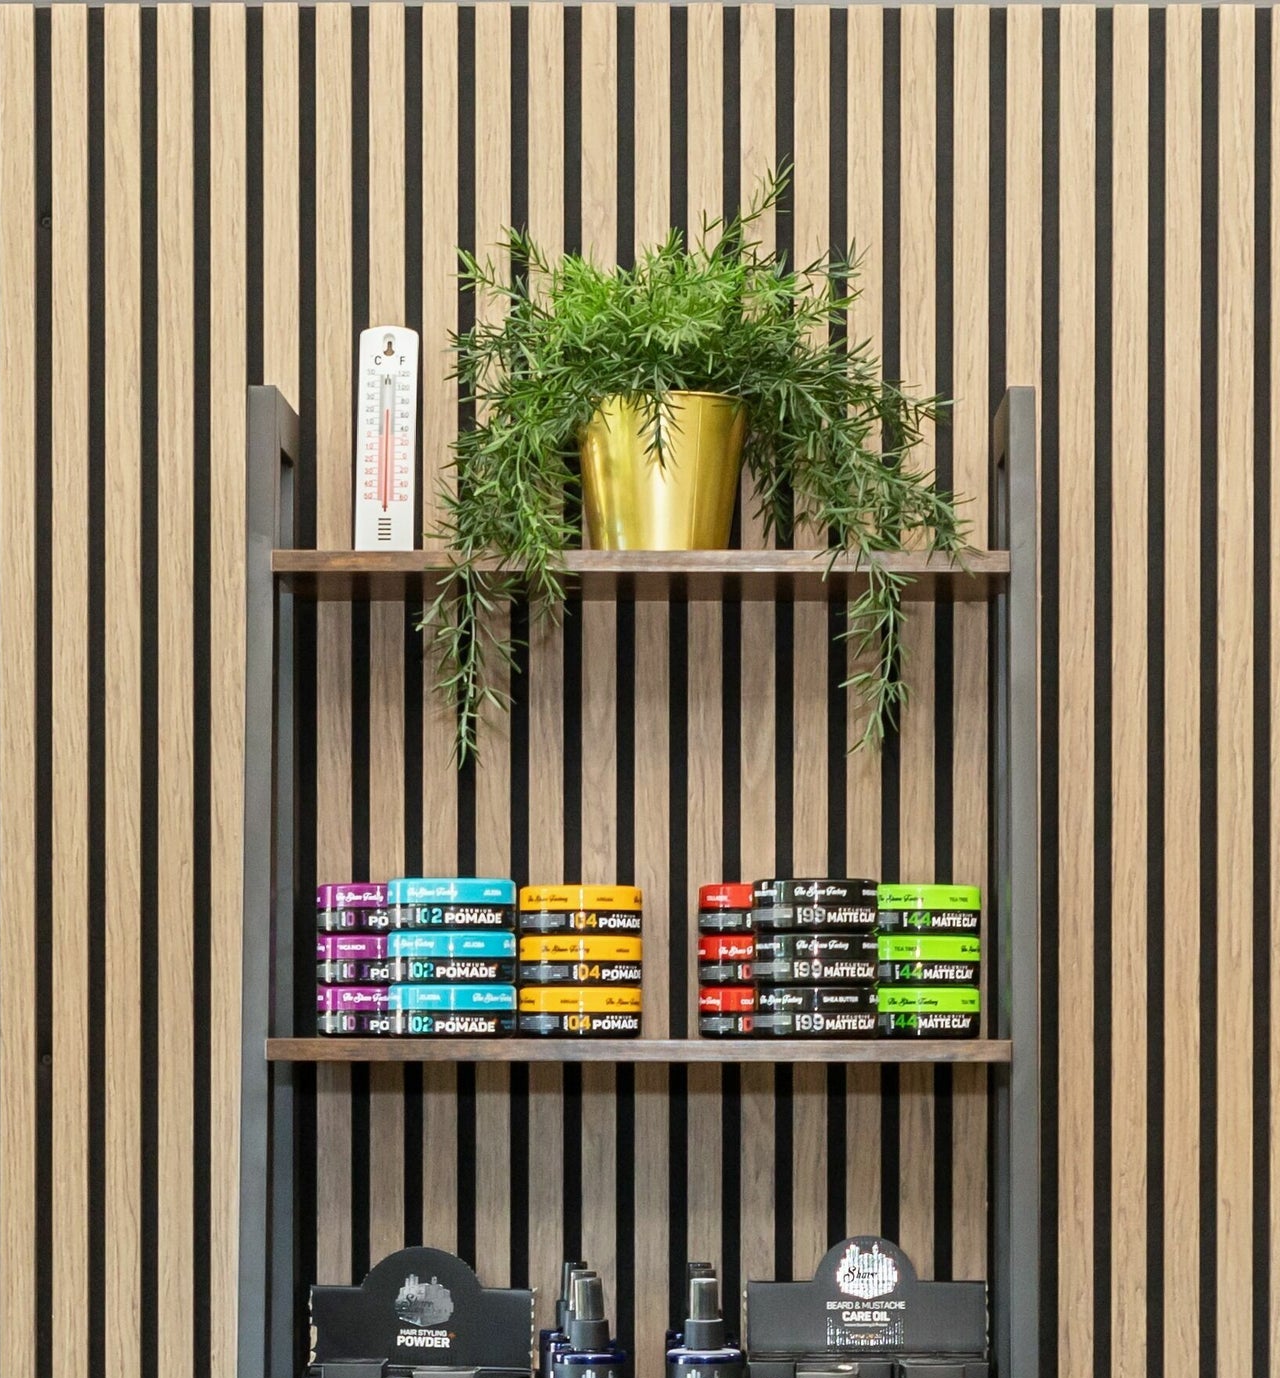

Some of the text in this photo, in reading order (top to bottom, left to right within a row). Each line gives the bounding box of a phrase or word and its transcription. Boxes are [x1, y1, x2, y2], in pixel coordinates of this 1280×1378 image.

[374, 355, 406, 365] C F
[444, 912, 502, 925] POMADE
[599, 917, 641, 928] POMADE
[803, 907, 875, 923] 99 MATTE CLAY
[908, 912, 978, 927] 44 MATTE CLAY
[412, 962, 496, 978] 02 POMADE
[578, 964, 600, 980] 04
[799, 961, 874, 978] 99 MATTE CLAY
[900, 964, 974, 980] 44 MATTE CLAY
[412, 1016, 496, 1033] 02 POMADE
[568, 1015, 638, 1031] 04 POMADE
[801, 1014, 875, 1031] 99 MATTE CLAY
[895, 1014, 971, 1029] 44 MATTE CLAY
[826, 1301, 853, 1310] BEARD
[861, 1301, 906, 1310] MUSTACHE
[842, 1311, 890, 1322] CARE OIL
[418, 1329, 447, 1337] STYLING
[396, 1335, 450, 1348] POWDER
